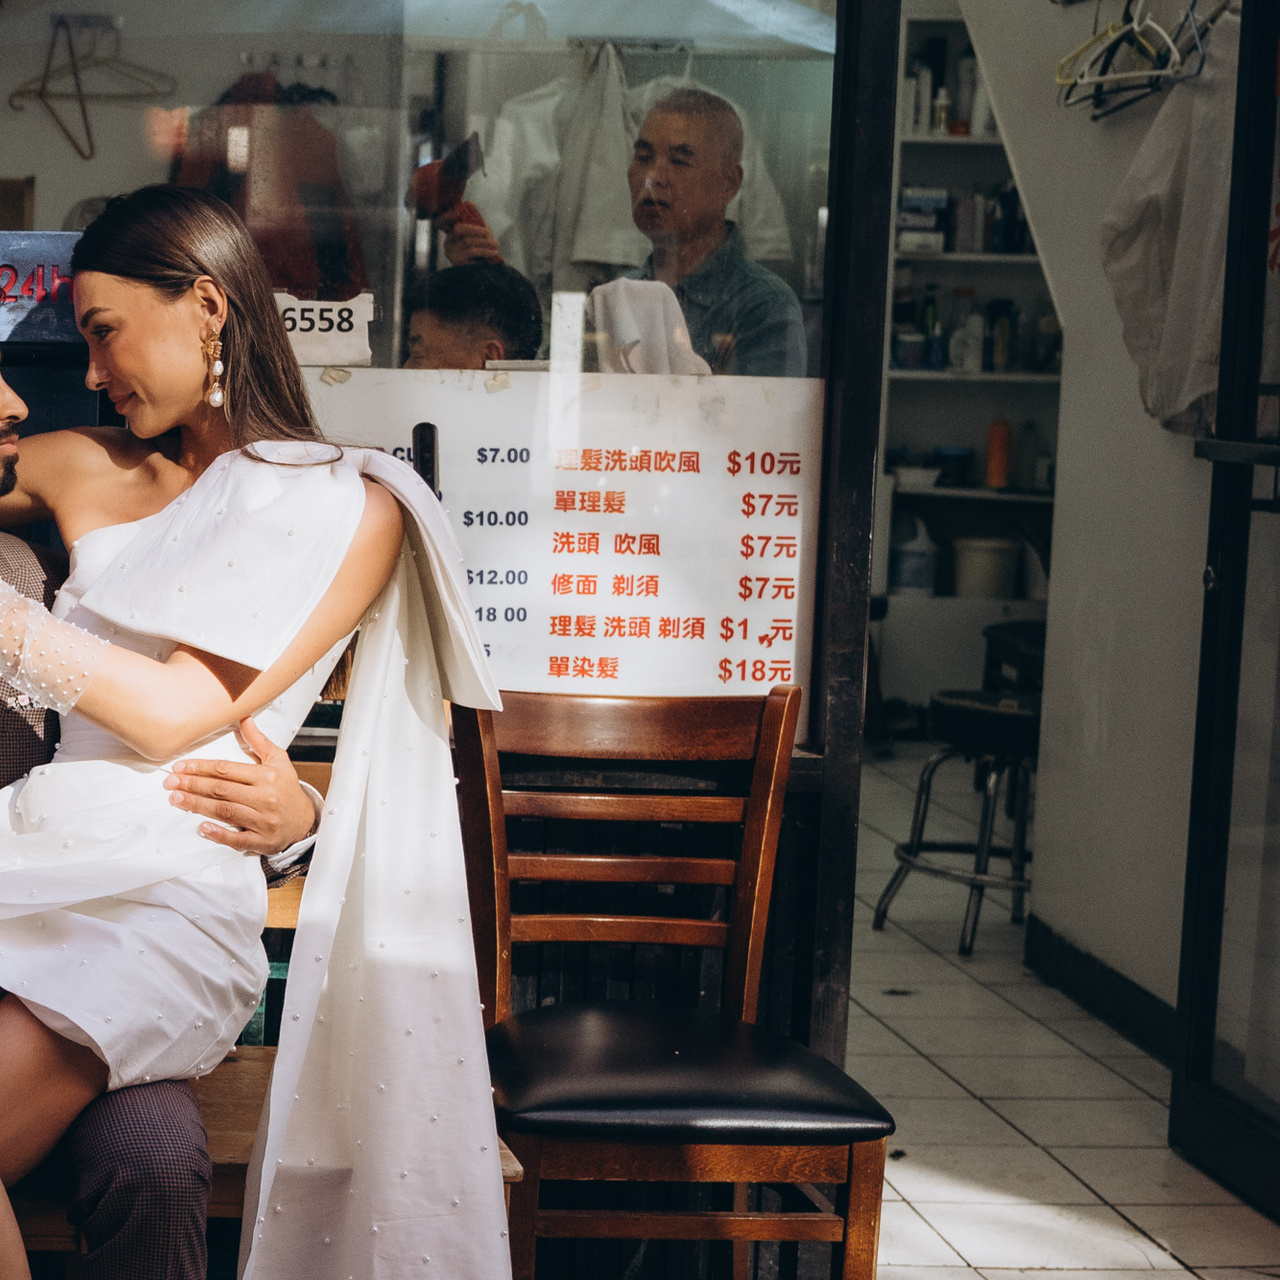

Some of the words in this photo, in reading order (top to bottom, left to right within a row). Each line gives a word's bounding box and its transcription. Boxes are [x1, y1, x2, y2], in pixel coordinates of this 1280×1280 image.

[282, 306, 355, 333] 6558
[476, 446, 531, 465] $7.00
[726, 450, 801, 477] $10元
[553, 490, 627, 514] 單理髮
[740, 492, 799, 519] $7元
[462, 510, 529, 528] $10.00
[551, 531, 600, 555] 洗頭
[614, 533, 661, 556] 吹風
[740, 533, 798, 560] $7元
[466, 568, 529, 585] $12.00
[550, 572, 598, 597] 修面
[611, 574, 660, 598] 剃須
[738, 575, 796, 601] $7元
[549, 615, 597, 638] 理髮
[603, 616, 651, 639] 洗頭
[658, 617, 706, 640] 剃須
[719, 616, 794, 643] $1元
[547, 656, 620, 679] 單染髮
[718, 657, 792, 683] $18元
